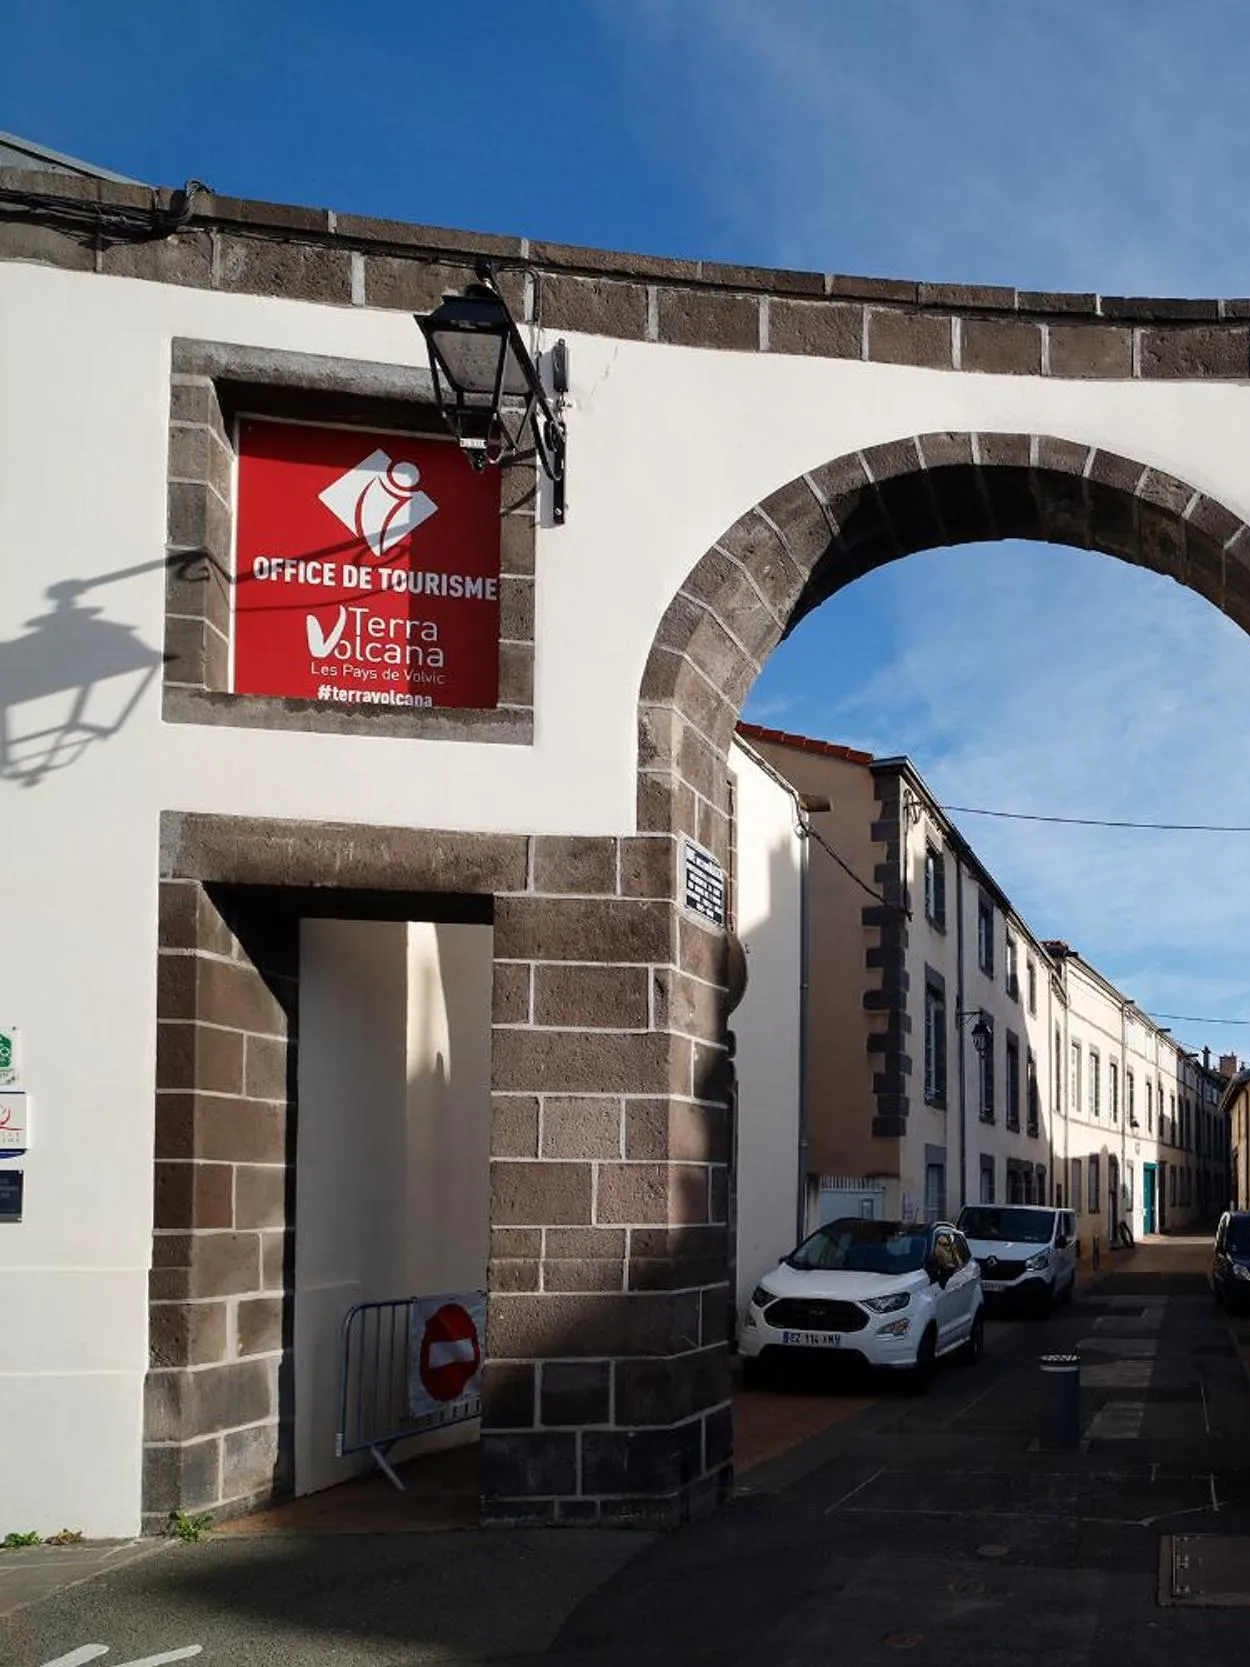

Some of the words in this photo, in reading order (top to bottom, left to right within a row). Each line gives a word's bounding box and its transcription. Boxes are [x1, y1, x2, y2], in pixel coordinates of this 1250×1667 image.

[253, 556, 336, 586] OFFICE
[342, 565, 375, 590] DE
[378, 568, 498, 601] TOURISME
[306, 605, 444, 668] Volcana
[349, 606, 439, 642] Terra
[311, 663, 338, 677] Les
[342, 664, 378, 681] Pays
[382, 669, 400, 681] de
[404, 669, 446, 685] Volvic
[317, 684, 433, 708] #terravolcana
